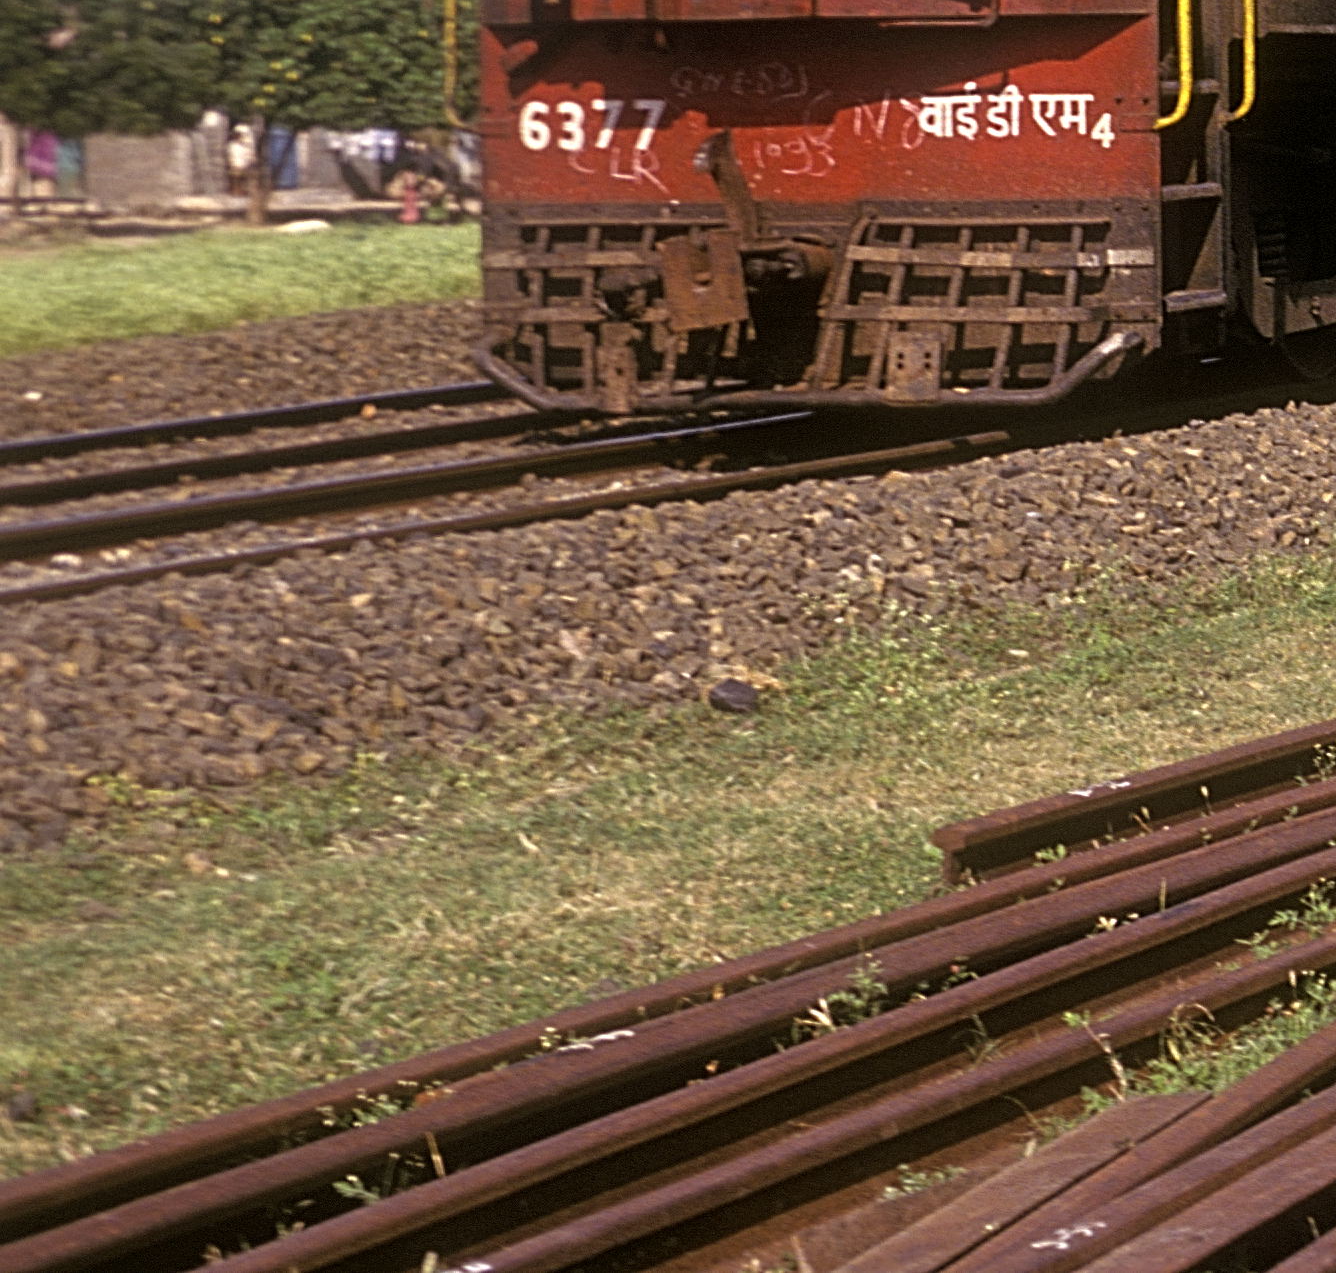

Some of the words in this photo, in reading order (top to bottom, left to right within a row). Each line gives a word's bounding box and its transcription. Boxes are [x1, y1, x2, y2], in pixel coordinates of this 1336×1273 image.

[519, 99, 666, 152] 6377
[1028, 93, 1095, 137] एम
[1091, 112, 1116, 149] 4
